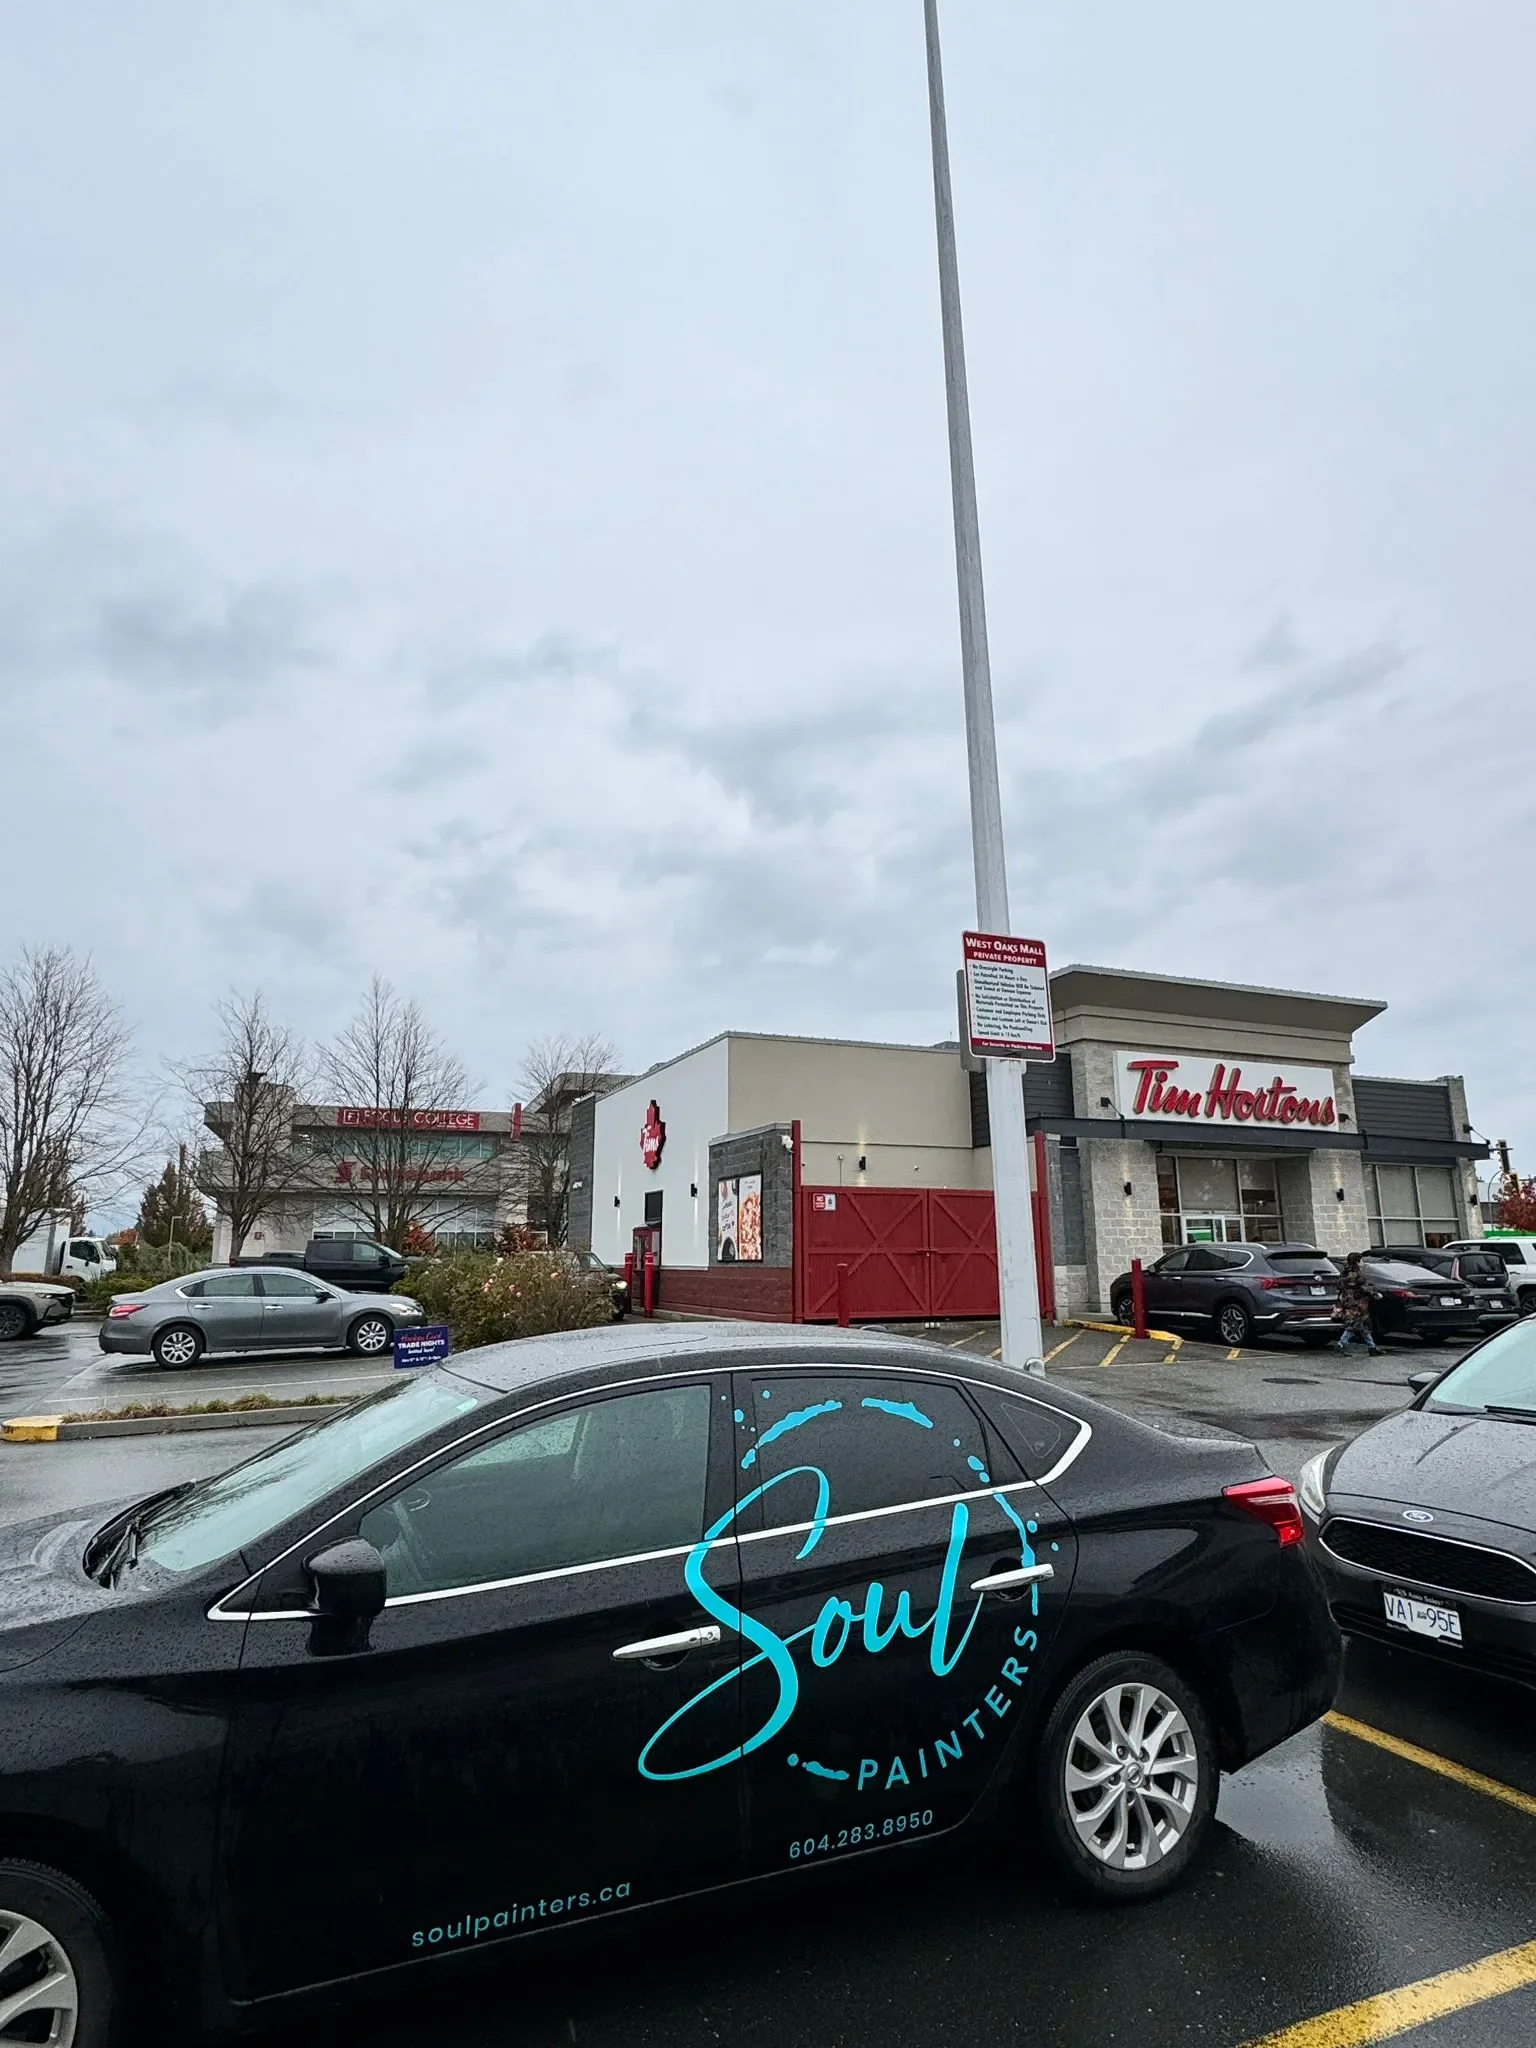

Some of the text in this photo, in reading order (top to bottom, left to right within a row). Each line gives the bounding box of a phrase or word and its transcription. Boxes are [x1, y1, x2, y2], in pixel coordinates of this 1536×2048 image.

[966, 937, 1044, 956] WEST OAKS MALL
[974, 952, 1037, 965] PRIVATE PROPERTY
[414, 1112, 474, 1126] COLLEGE
[1127, 1060, 1336, 1126] Tim Hortons
[638, 1466, 985, 1780] Soul
[857, 1626, 1038, 1790] PAINTERS
[789, 1810, 933, 1858] 604.283.8950
[412, 1882, 631, 1947] soulpainters.ca
